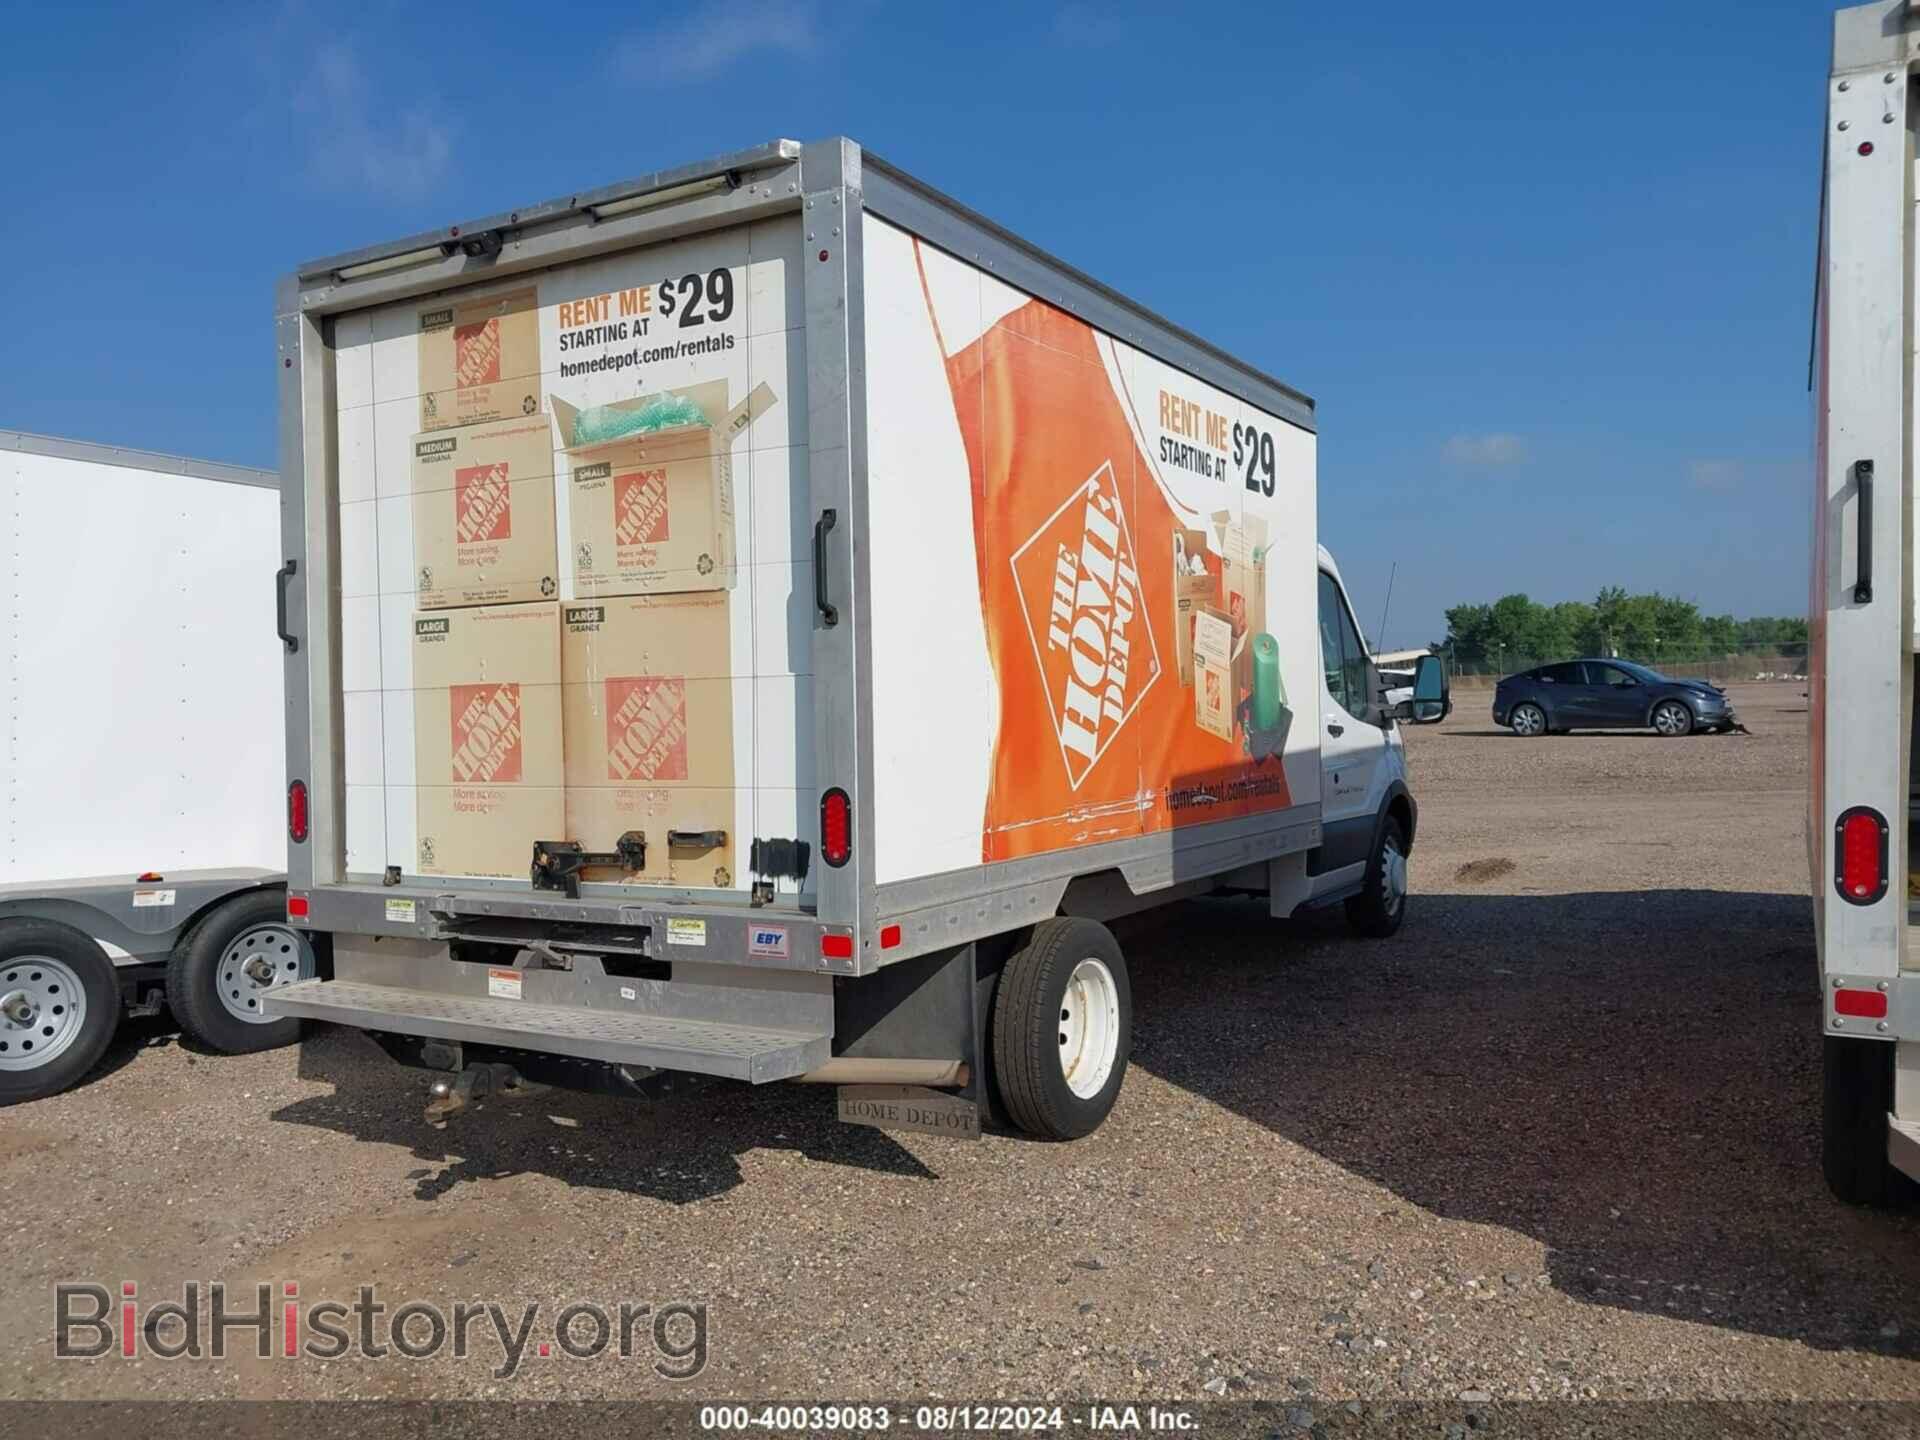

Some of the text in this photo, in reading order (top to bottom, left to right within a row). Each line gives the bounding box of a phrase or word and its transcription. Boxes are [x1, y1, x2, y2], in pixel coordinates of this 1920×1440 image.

[559, 267, 735, 329] RENT ME $29
[559, 317, 651, 352] STARTING AT
[560, 332, 735, 378] homedepot.com/rentals
[419, 439, 453, 454] MEDIUM
[1159, 389, 1276, 498] RENT ME $29
[1159, 436, 1227, 483] STARTING AT
[457, 463, 509, 543] HOME
[616, 470, 667, 545] HOME
[636, 496, 668, 543] DEPOT
[569, 610, 600, 621] LARGE
[1048, 543, 1079, 653] THE
[1062, 479, 1123, 763] HOME
[419, 621, 446, 632] LARGE
[1103, 551, 1138, 725] DEPOT
[452, 683, 521, 782] HOME
[457, 691, 488, 734] THE
[608, 676, 686, 780] HOME
[613, 686, 650, 729] THE
[479, 716, 522, 783] DEPOT
[638, 709, 687, 782] DEPOT
[756, 932, 783, 945] EBY
[844, 1101, 974, 1130] HOME DEPOT
